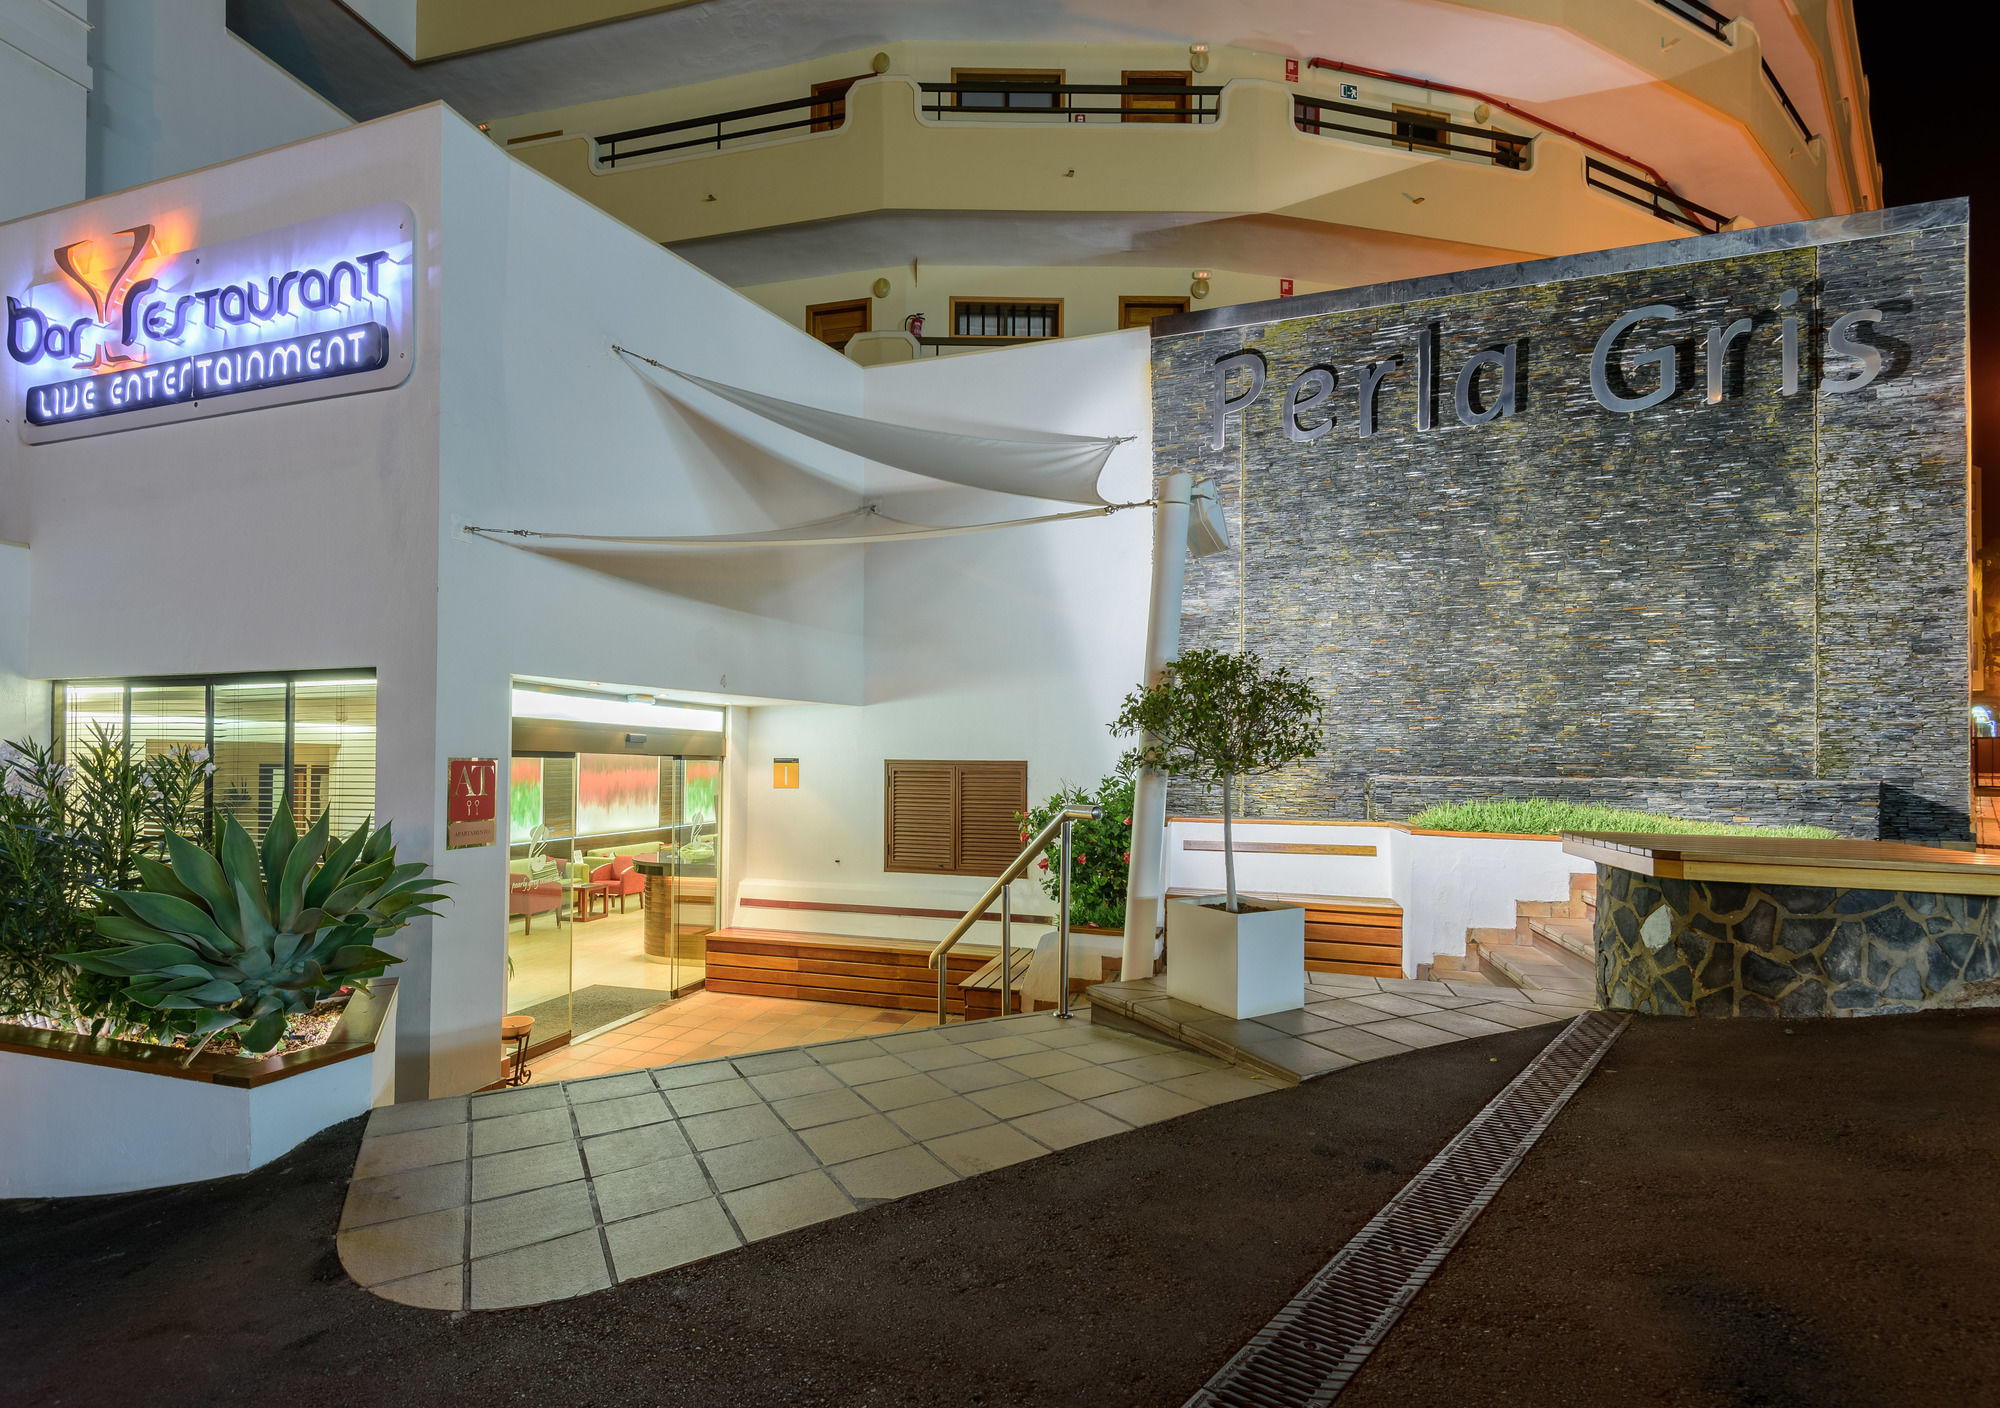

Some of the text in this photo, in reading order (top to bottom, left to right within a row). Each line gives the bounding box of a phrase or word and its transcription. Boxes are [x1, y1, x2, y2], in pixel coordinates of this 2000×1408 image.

[39, 331, 366, 418] LIVE ENTERTAINMENT
[1211, 288, 1884, 452] Perla Gris
[453, 764, 495, 797] AT
